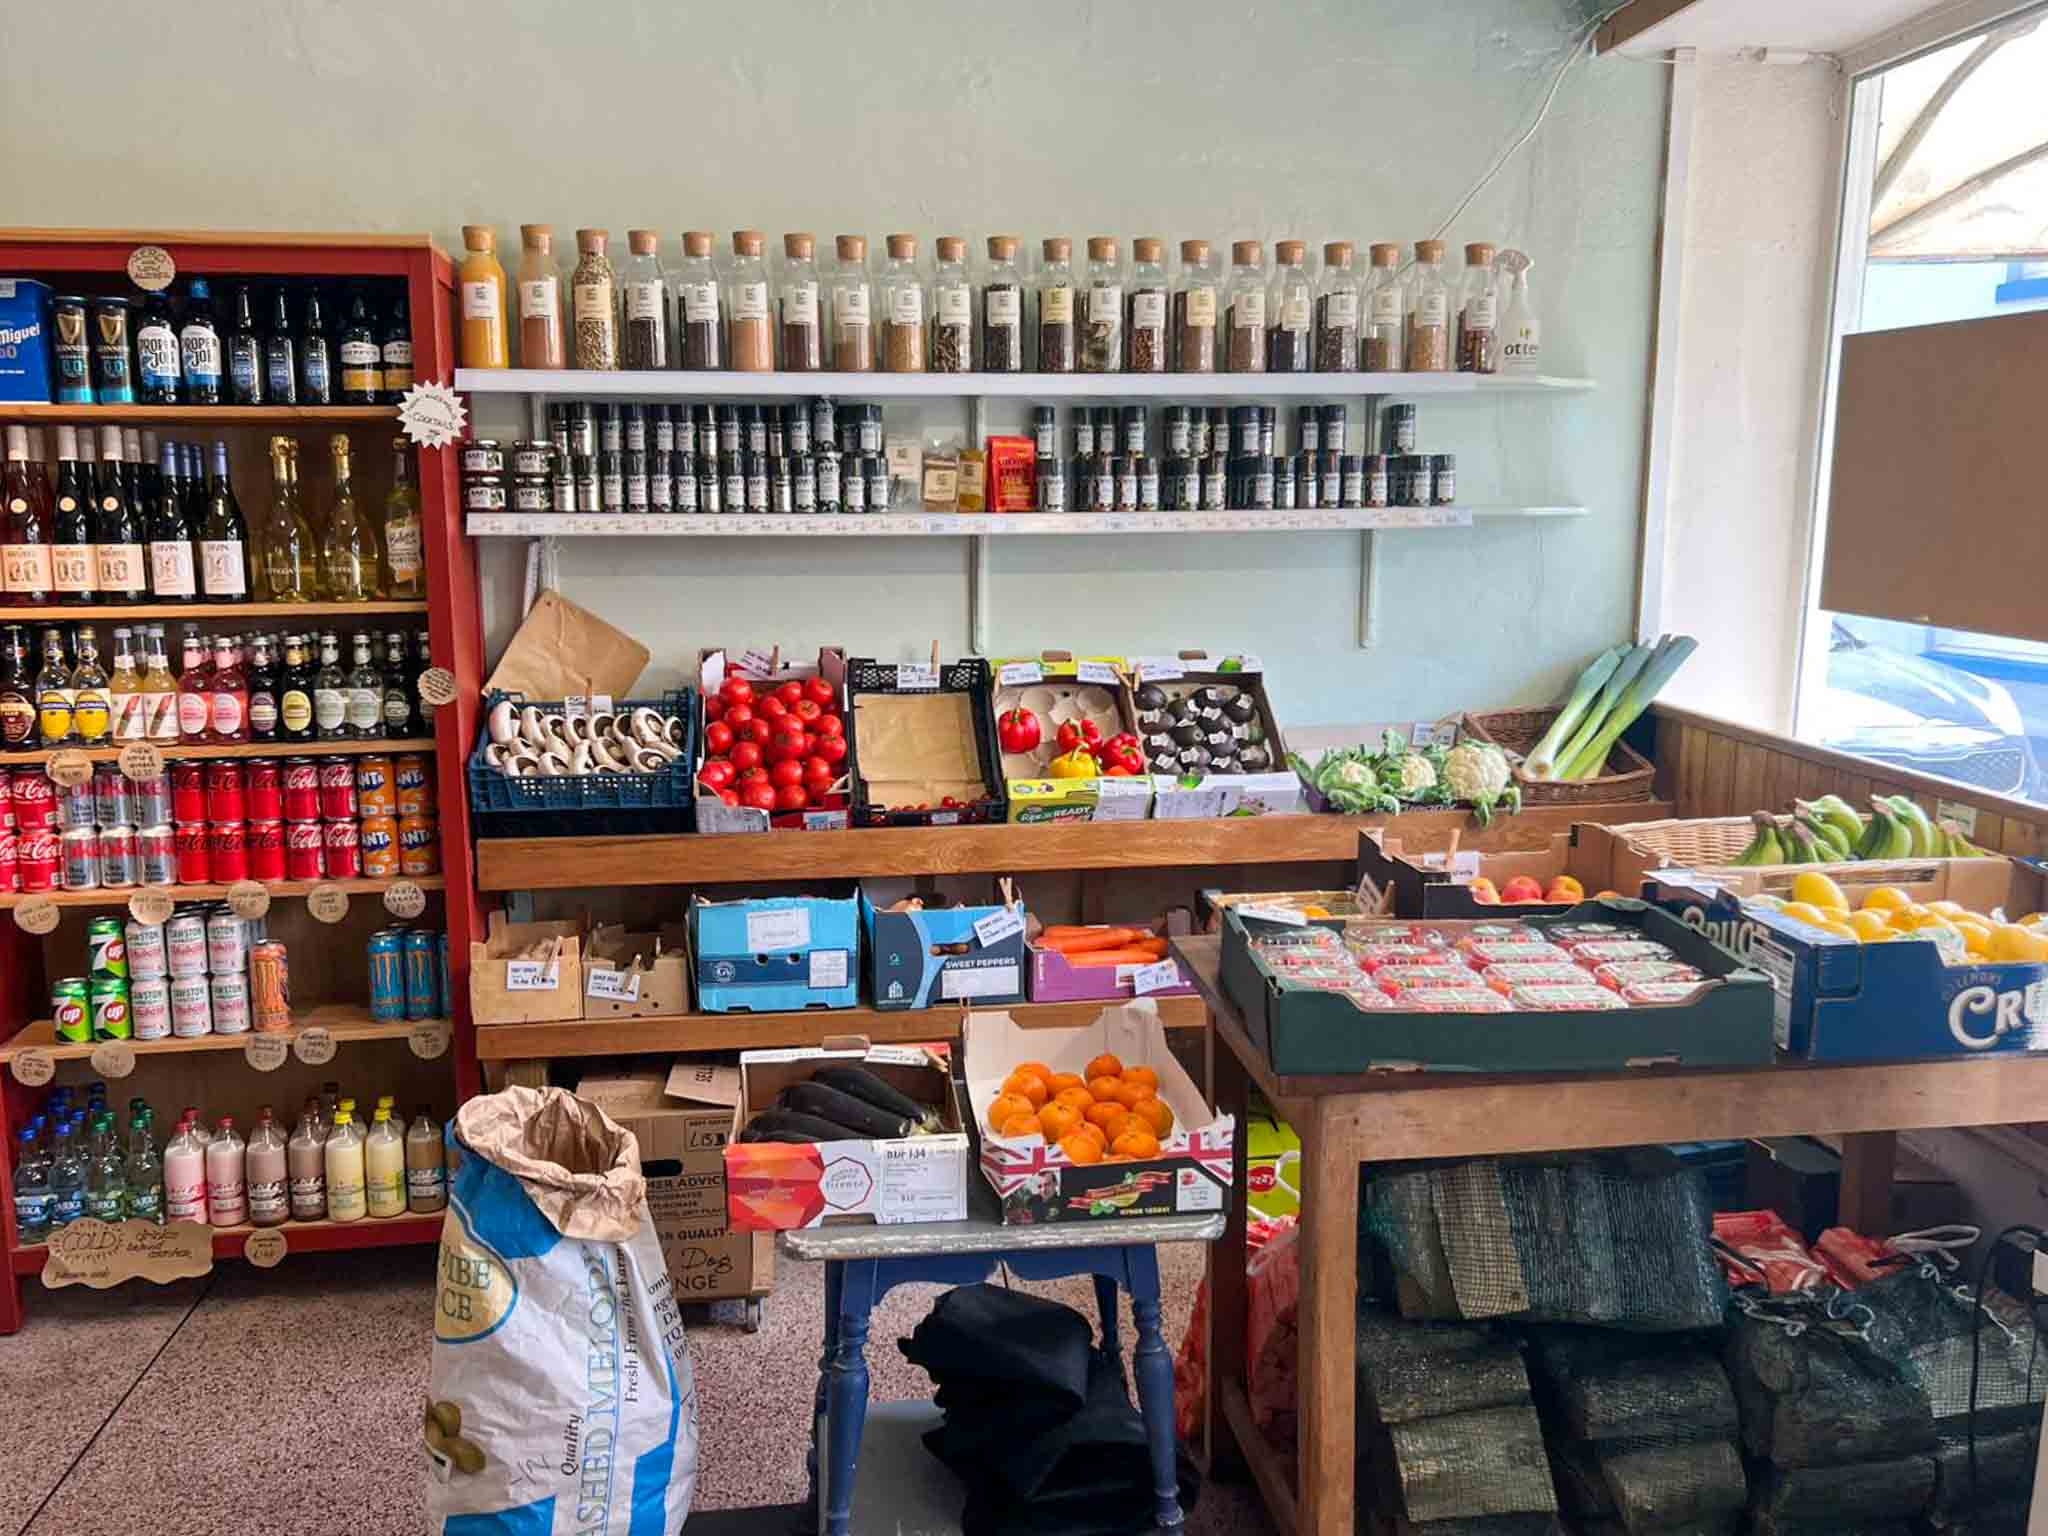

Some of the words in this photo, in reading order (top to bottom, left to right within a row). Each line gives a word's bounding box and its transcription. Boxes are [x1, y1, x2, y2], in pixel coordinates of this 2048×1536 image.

[945, 960, 976, 969] SWEET
[976, 957, 1016, 967] PEPPERS
[678, 1175, 722, 1186] ADVIC
[673, 1275, 720, 1291] NGE
[623, 1357, 639, 1403] Fresh
[560, 1412, 584, 1476] Quality
